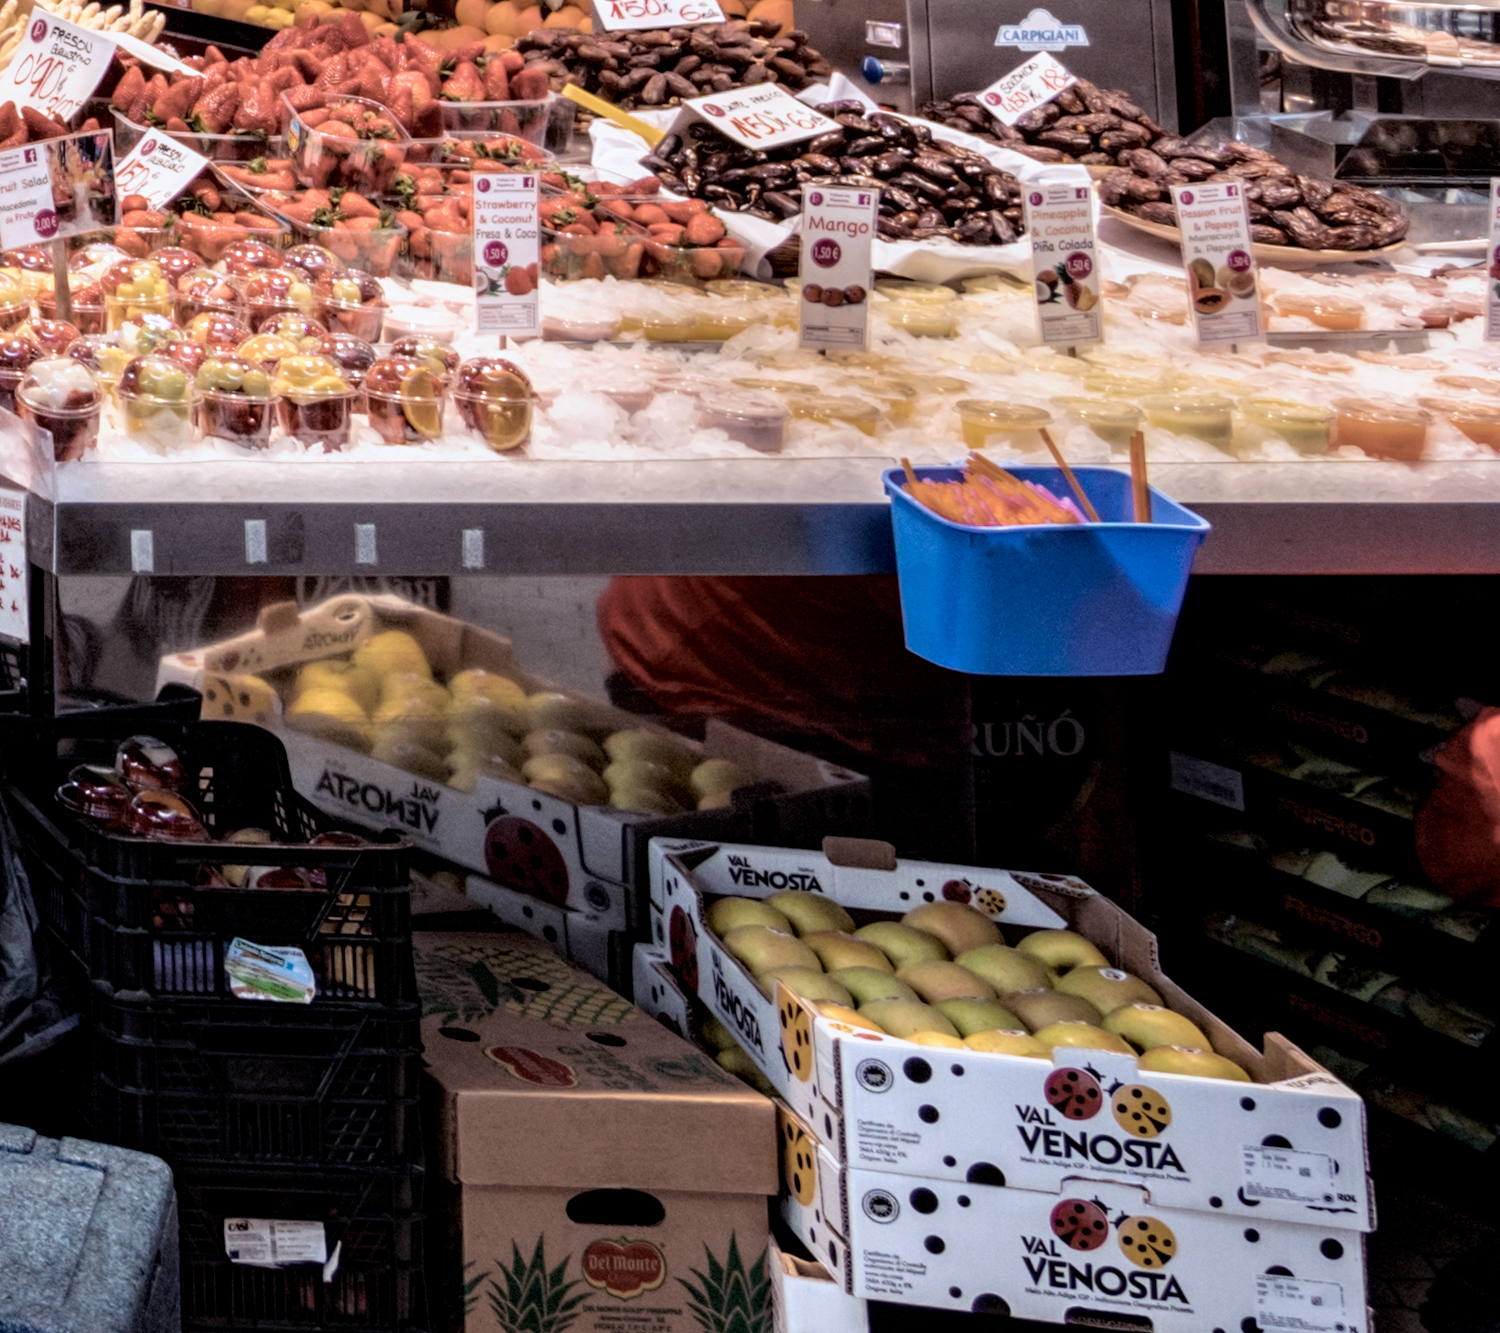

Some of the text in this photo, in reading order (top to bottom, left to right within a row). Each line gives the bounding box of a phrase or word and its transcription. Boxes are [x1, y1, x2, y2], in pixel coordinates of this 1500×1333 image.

[1001, 28, 1082, 43] CARPIGIANI
[21, 175, 49, 190] Salad
[475, 199, 537, 212] Strawberry
[1180, 204, 1242, 219] Passion Fruit
[479, 213, 533, 225] & Coconut
[1031, 207, 1088, 222] Pineapple
[476, 228, 537, 240] Fresa & Coco
[808, 215, 870, 238] Mango
[1031, 223, 1091, 237] & Coconut
[1204, 220, 1239, 233] Papaya
[1033, 238, 1094, 253] Piña Colada
[727, 855, 749, 870] VAL
[729, 867, 823, 893] VENOSTA
[710, 948, 723, 977] VAL
[710, 967, 764, 1051] VENOSTA
[1015, 1104, 1056, 1127] VAL
[1016, 1123, 1188, 1174] VENOSTA
[1020, 1235, 1062, 1258] VAL
[587, 1254, 660, 1272] Del Monte
[1022, 1254, 1190, 1305] VENOSTA
